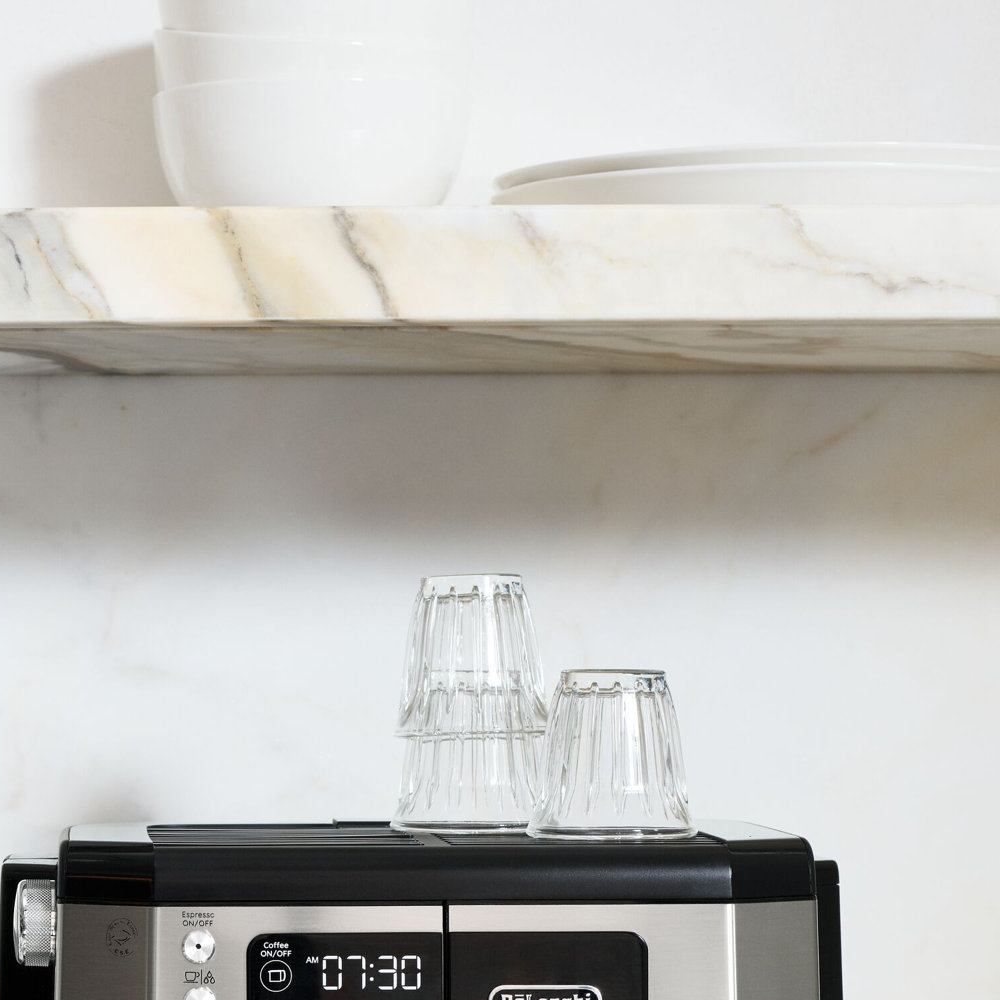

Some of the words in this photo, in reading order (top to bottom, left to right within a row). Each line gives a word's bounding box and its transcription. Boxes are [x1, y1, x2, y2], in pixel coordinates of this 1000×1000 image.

[263, 941, 289, 950] Coffee
[260, 950, 292, 958] ON/OFF
[306, 956, 319, 964] AM
[322, 955, 421, 991] 07:30
